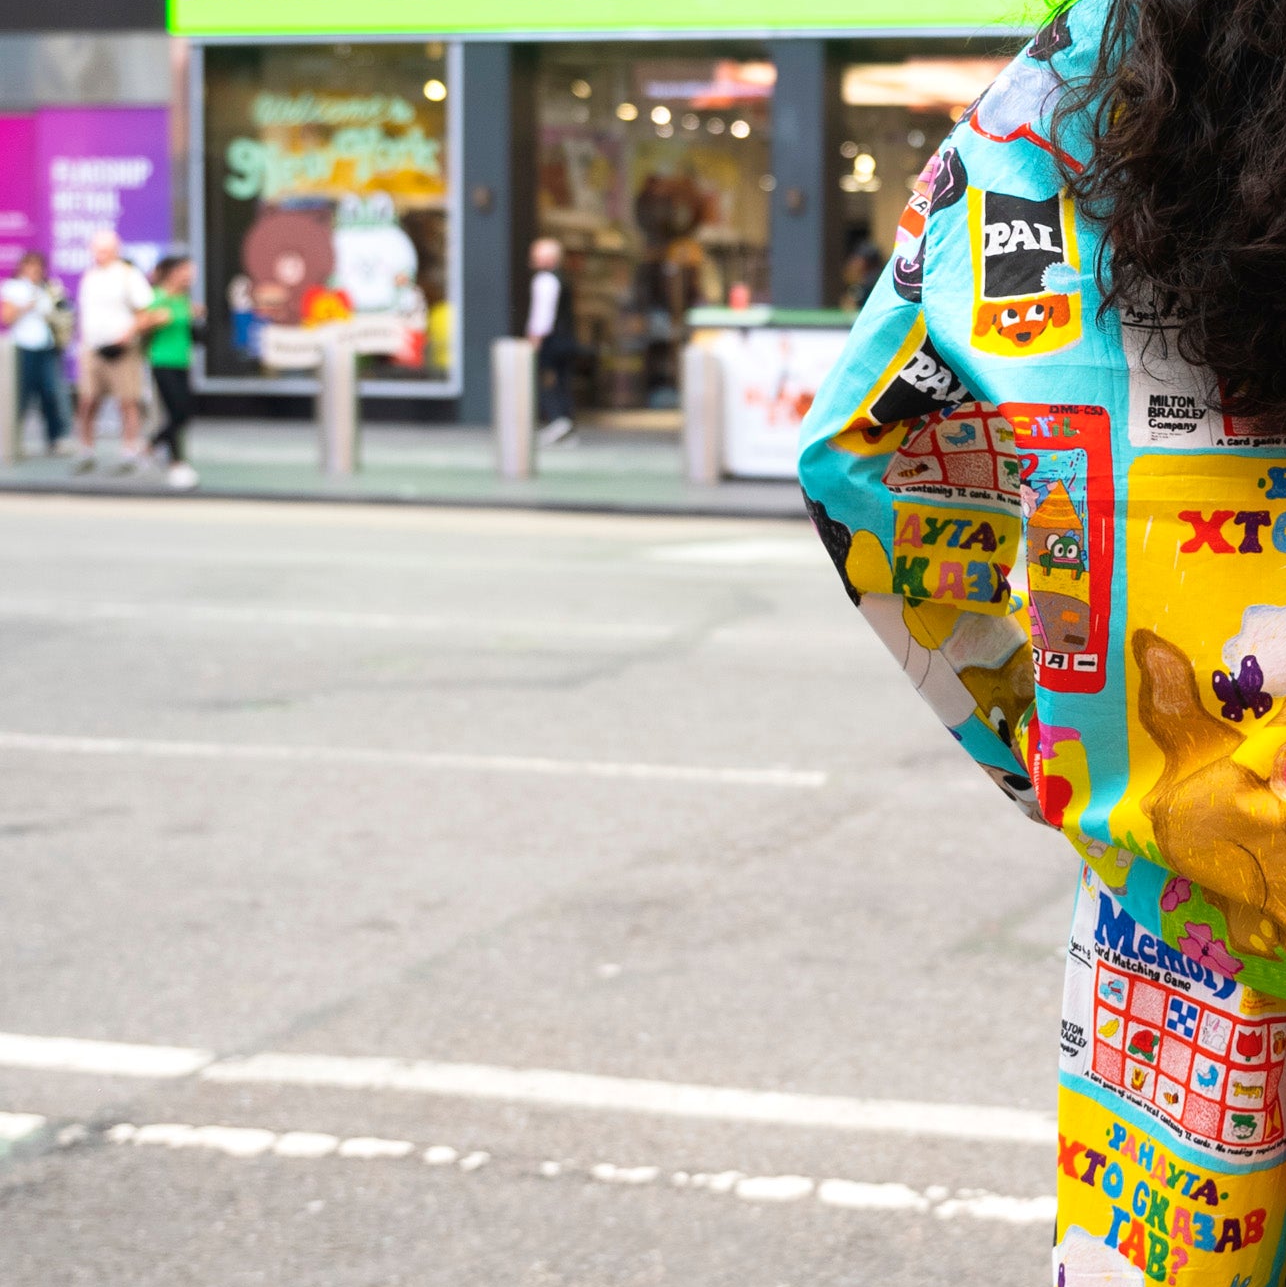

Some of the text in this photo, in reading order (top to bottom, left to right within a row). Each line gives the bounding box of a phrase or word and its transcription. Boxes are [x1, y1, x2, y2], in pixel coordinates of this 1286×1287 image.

[984, 220, 1063, 257] PAL
[1149, 394, 1196, 408] MILTON
[1147, 406, 1207, 420] BRADLEY
[1148, 418, 1197, 433] Company
[1112, 954, 1160, 983] Matching
[1163, 972, 1191, 992] Game
